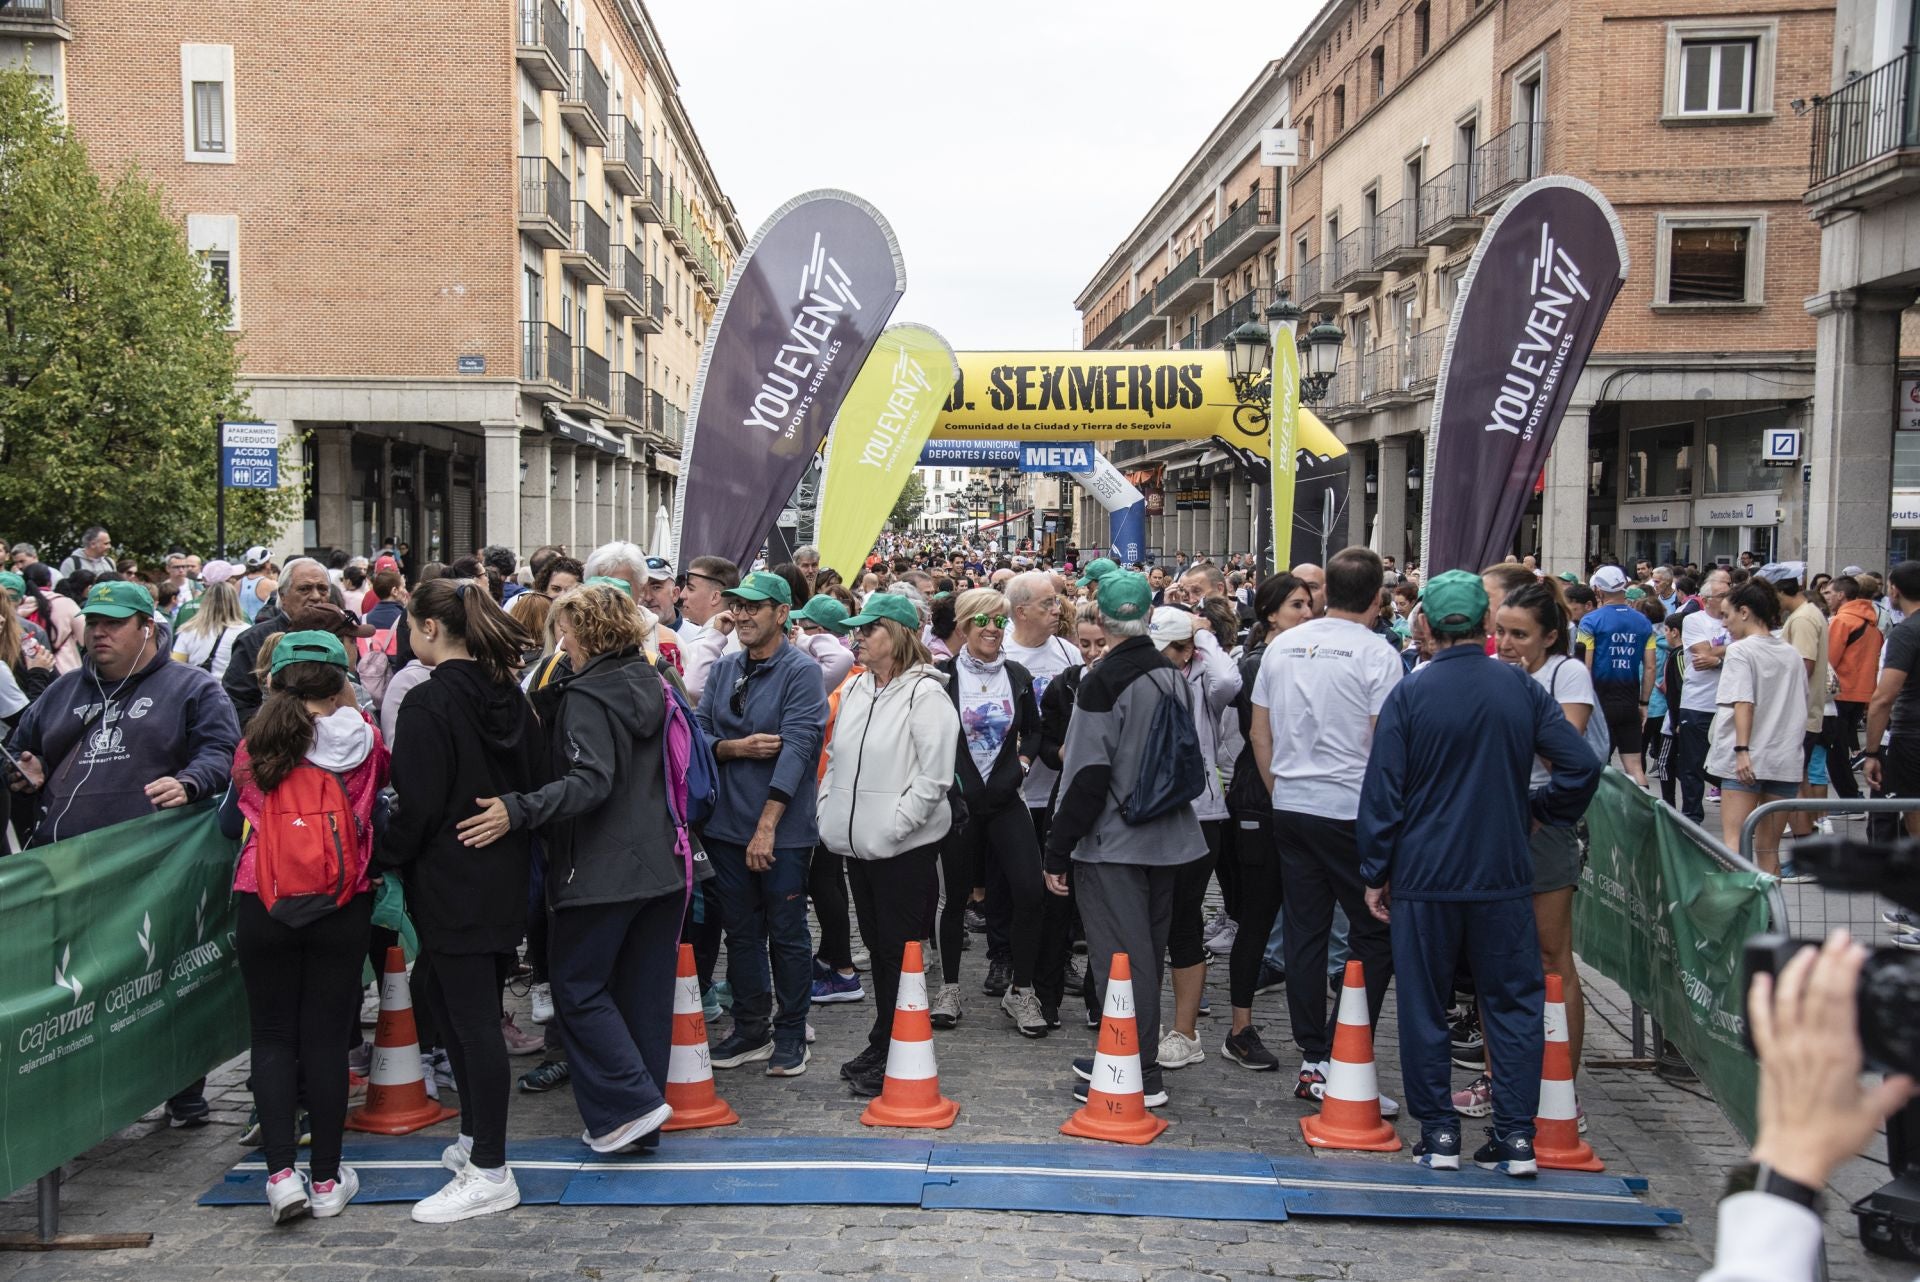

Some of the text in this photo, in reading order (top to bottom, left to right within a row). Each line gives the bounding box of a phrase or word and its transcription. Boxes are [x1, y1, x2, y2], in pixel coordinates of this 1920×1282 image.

[784, 339, 842, 440] SPORTS SERVICES
[986, 363, 1203, 418] SEXMEROS
[1523, 332, 1574, 441] SPORTS SERVICES
[743, 372, 799, 432] YOU
[1485, 373, 1535, 435] YOU
[944, 421, 1172, 432] Comunidad de la Ciudad y Tierra de Segovia
[227, 436, 277, 444] ACUEDUCTO
[858, 429, 894, 469] YOU
[929, 440, 1019, 450] INSTITUTO MUNICIPAL
[234, 448, 270, 457] ACCESO
[928, 450, 980, 460] DEPORTES
[1026, 447, 1089, 467] META
[231, 458, 273, 467] PEATONAL
[1092, 479, 1112, 499] 2025
[1632, 514, 1661, 524] Deutsche Bank
[1710, 510, 1744, 520] Deutsche Bank
[1892, 511, 1920, 520] euts
[1611, 632, 1637, 644] ONE
[1608, 646, 1636, 656] TWO
[1611, 658, 1631, 670] TRI
[113, 753, 131, 761] POLO
[168, 940, 224, 982] cajaviva
[104, 968, 163, 1015] cajaviva
[1112, 994, 1130, 1012] YE
[19, 1000, 96, 1054] cajaviva
[1109, 1023, 1128, 1046] YE
[18, 1033, 95, 1075] cajarural Fundación
[694, 1047, 711, 1071] YE
[1107, 1063, 1125, 1085] YE
[1105, 1099, 1123, 1117] YE
